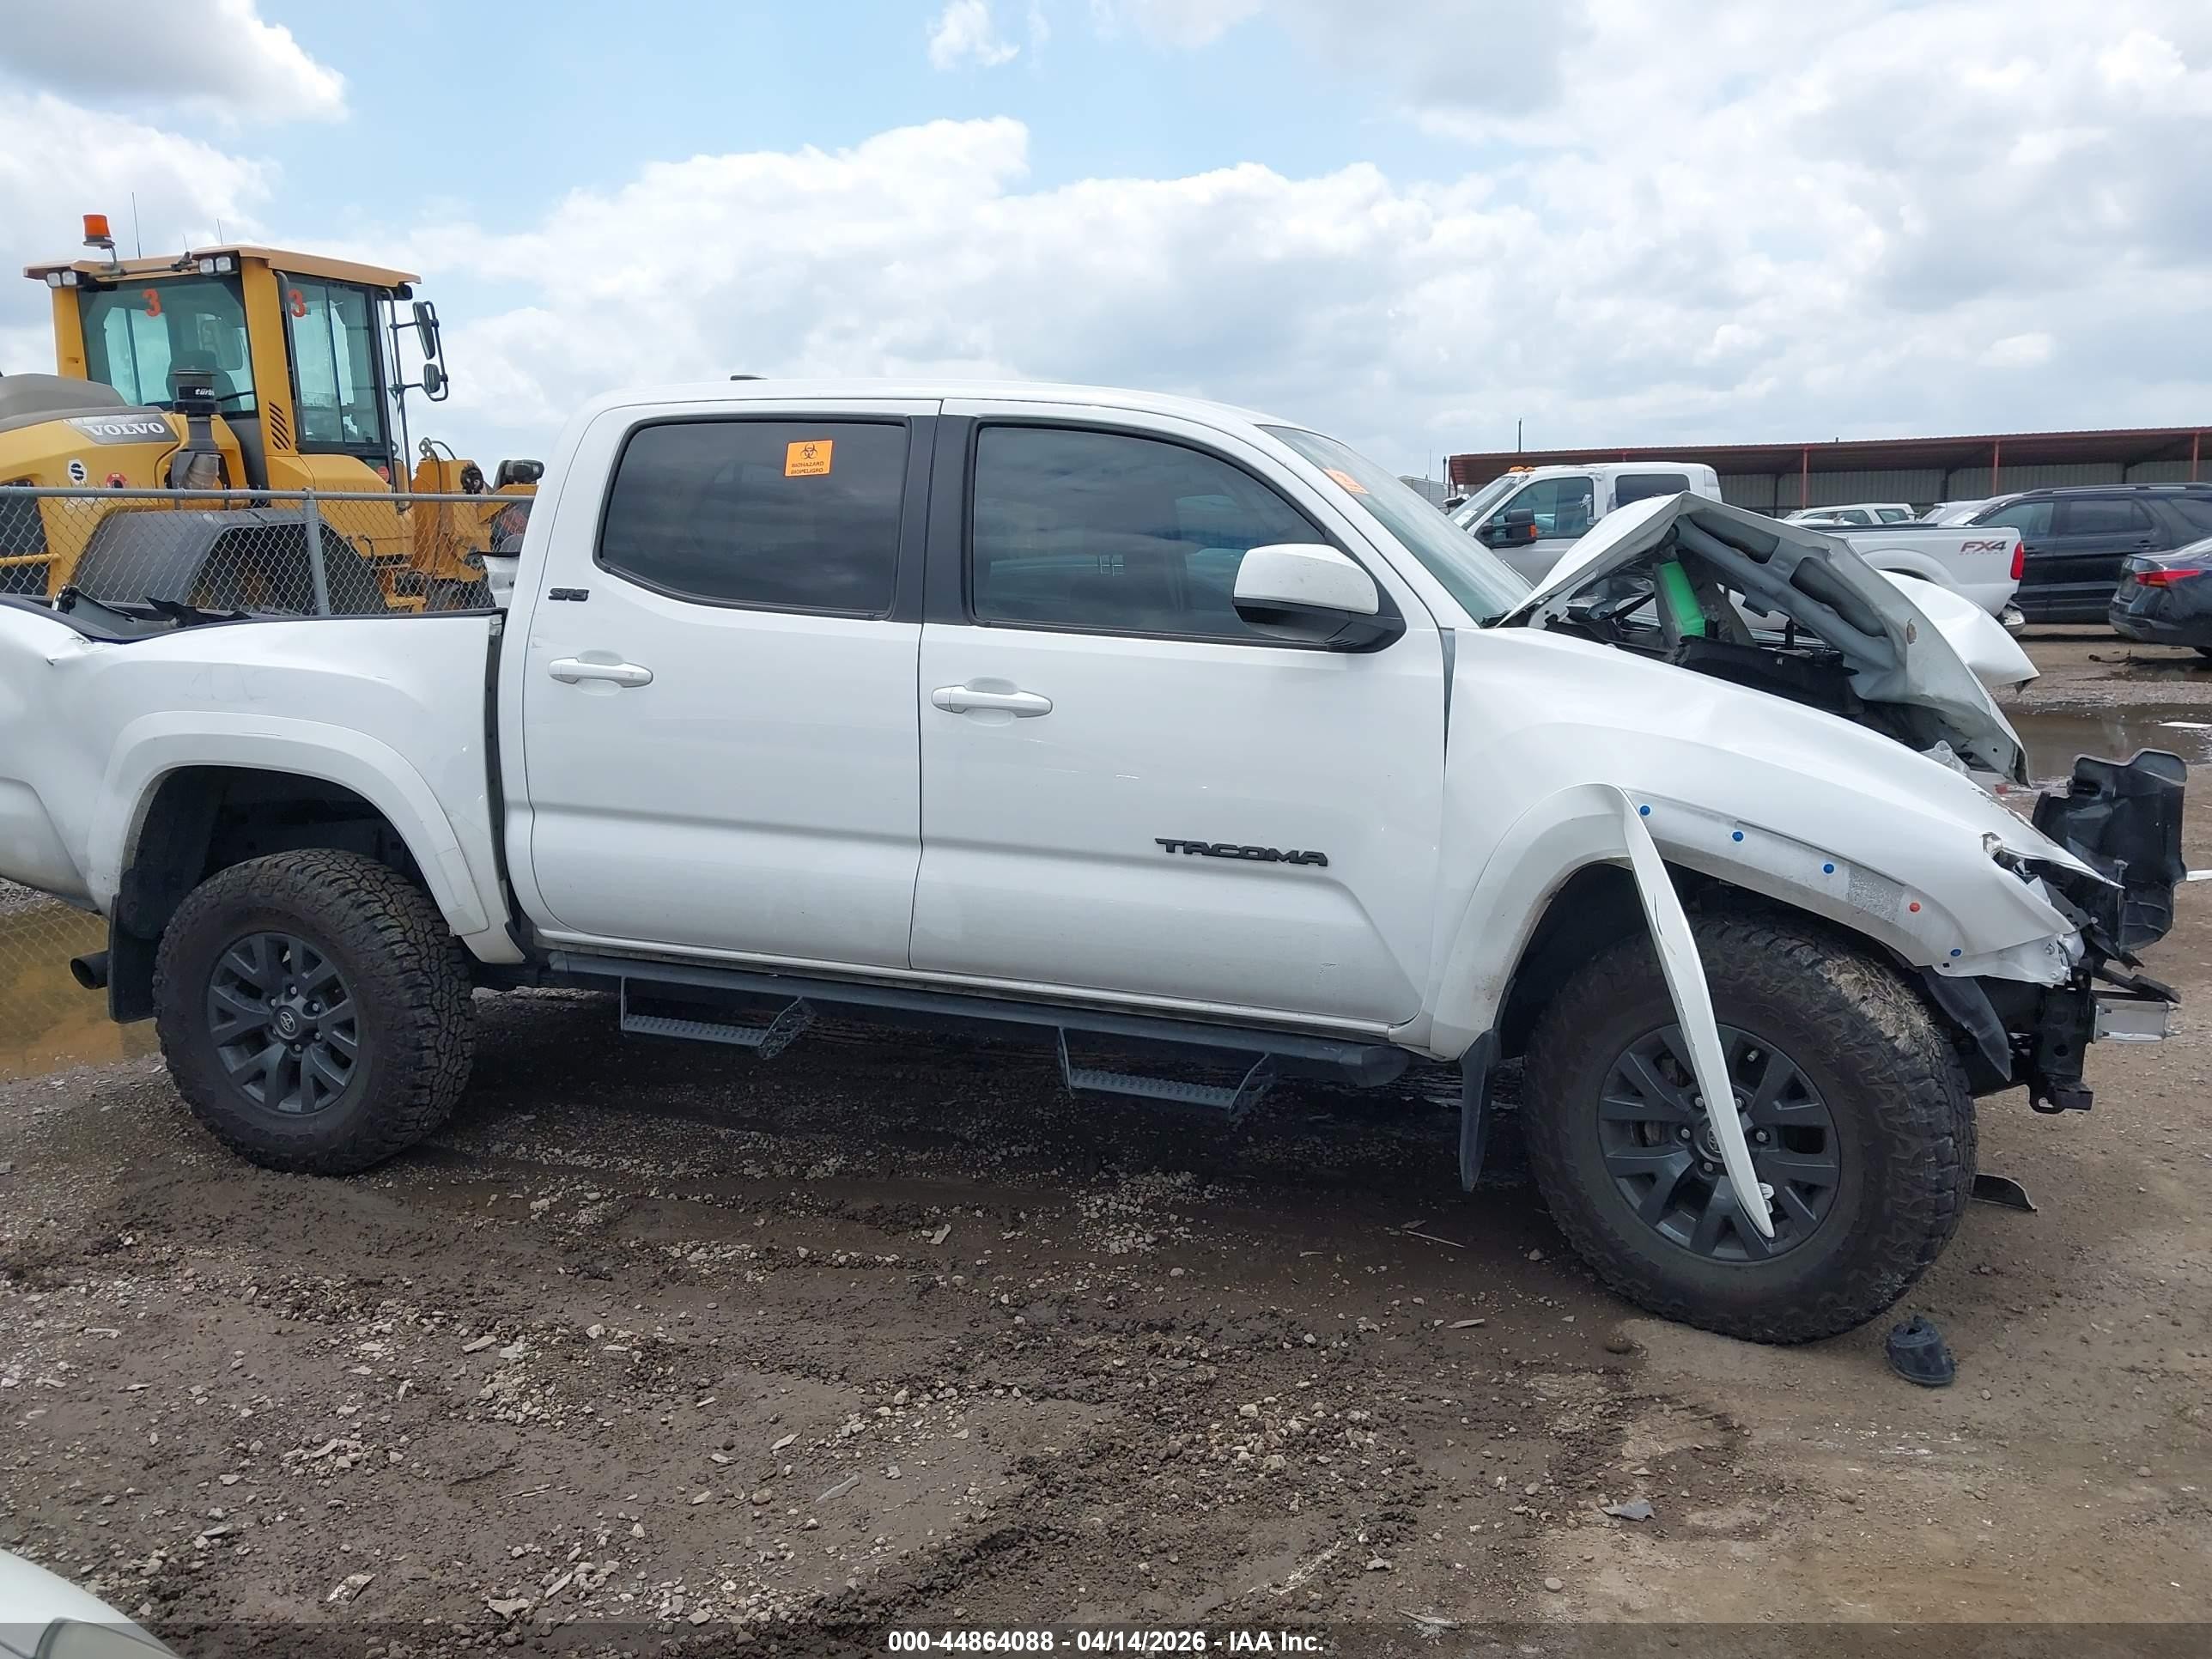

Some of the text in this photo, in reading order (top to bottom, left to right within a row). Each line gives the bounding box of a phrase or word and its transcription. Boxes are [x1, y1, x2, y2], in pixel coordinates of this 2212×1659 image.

[142, 288, 161, 317] 3
[289, 289, 306, 318] 3
[83, 422, 165, 436] VOLVO
[1960, 540, 2007, 552] FX4
[1154, 837, 1328, 867] TACOMA
